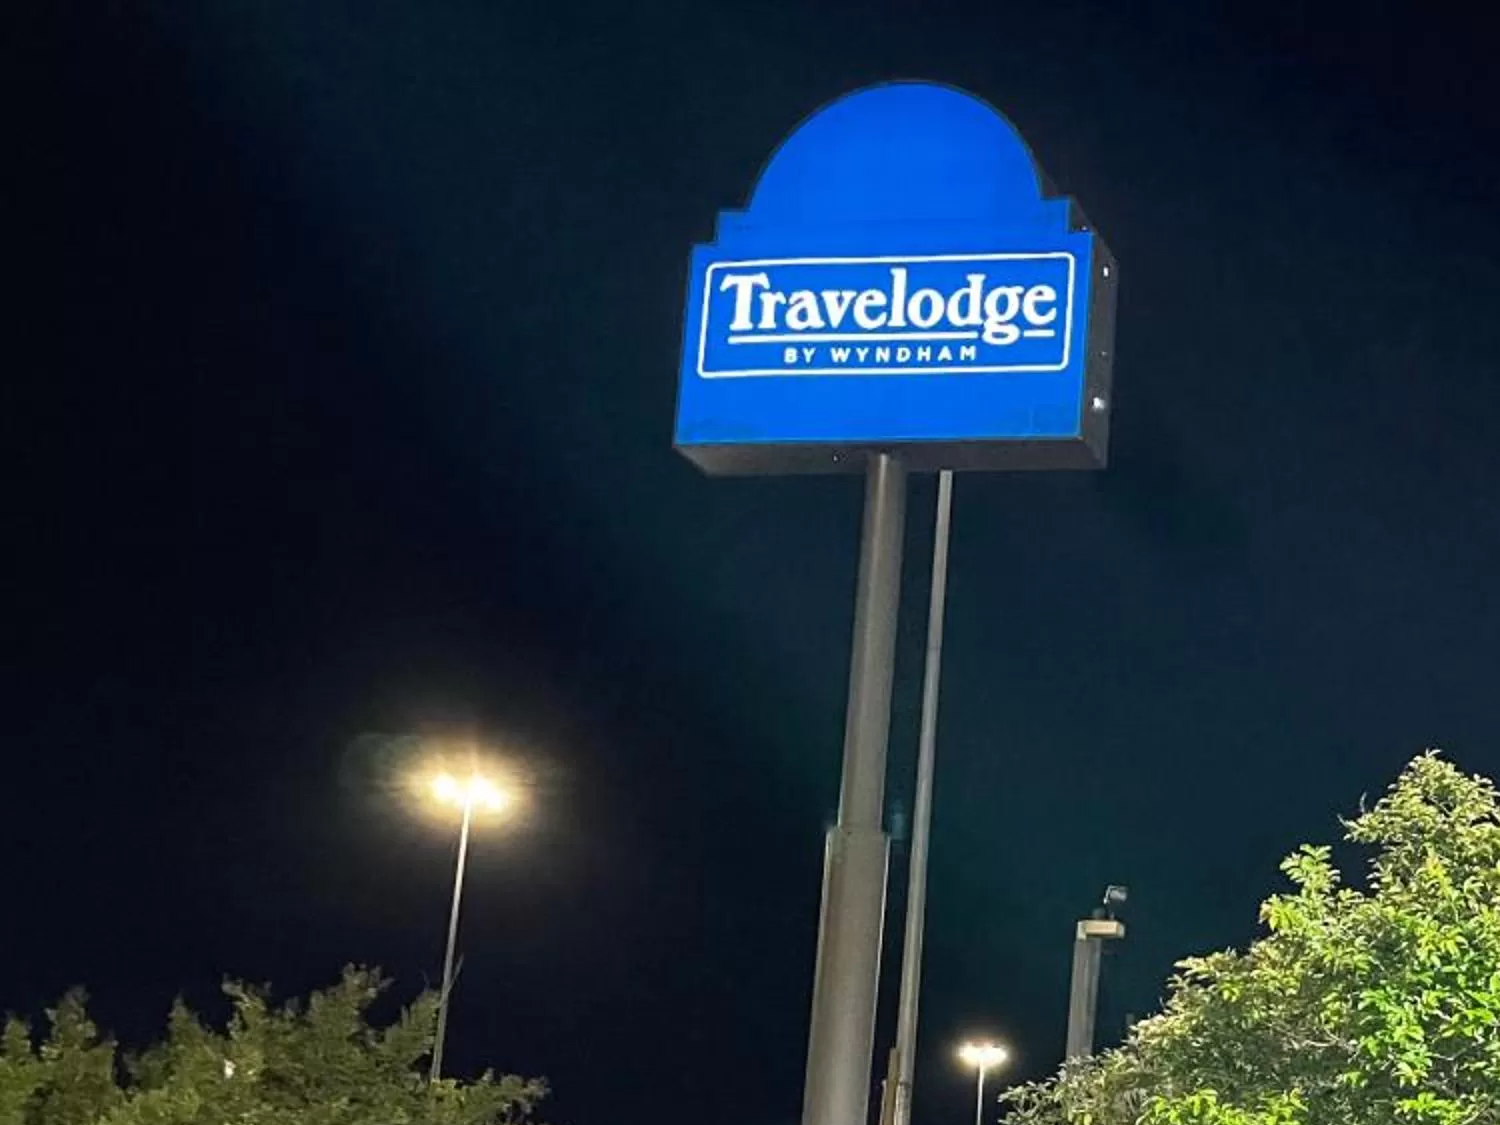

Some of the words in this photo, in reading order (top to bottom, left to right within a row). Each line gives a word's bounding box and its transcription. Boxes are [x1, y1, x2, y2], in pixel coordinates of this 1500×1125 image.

[720, 268, 1057, 345] Travelodge
[783, 347, 816, 364] BY
[831, 345, 977, 363] WYNDHAM
